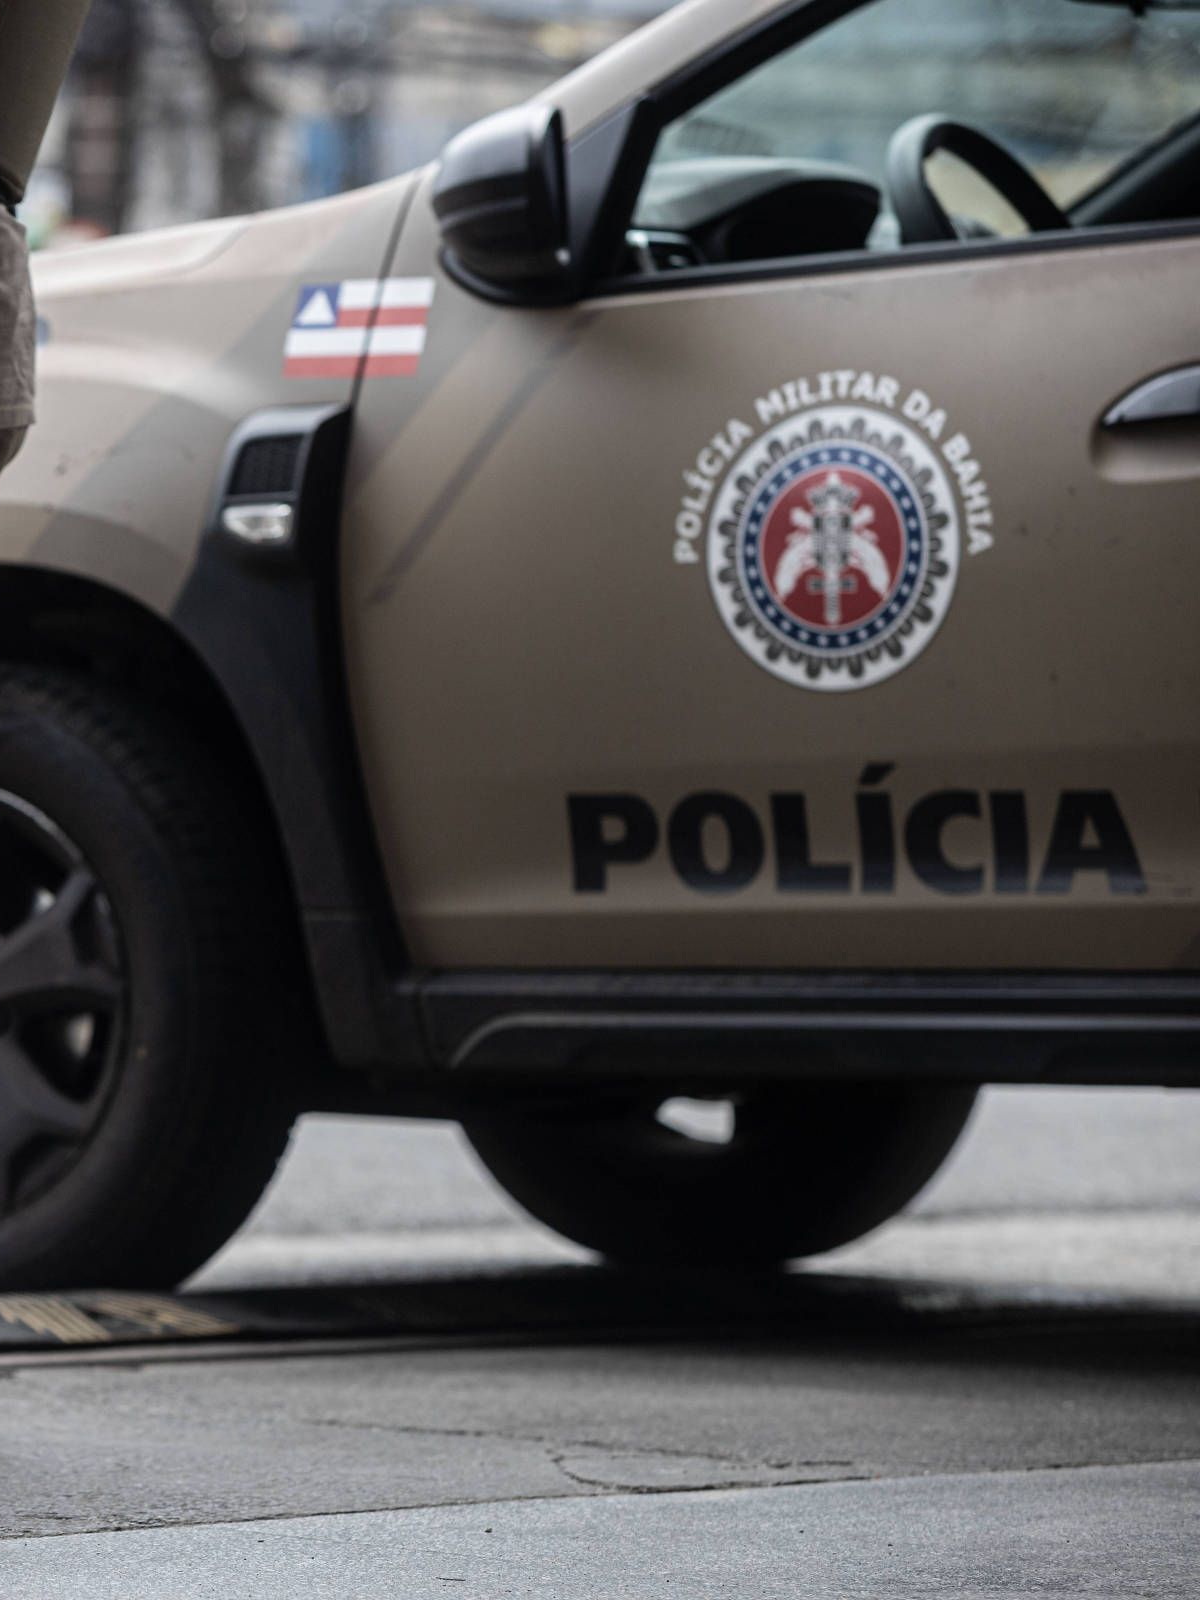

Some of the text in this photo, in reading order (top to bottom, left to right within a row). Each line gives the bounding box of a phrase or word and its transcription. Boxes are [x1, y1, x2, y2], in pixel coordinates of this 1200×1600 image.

[673, 370, 994, 564] POLÍCIA MILITAR DA BAHIA
[566, 762, 1148, 894] POLÍCIA
